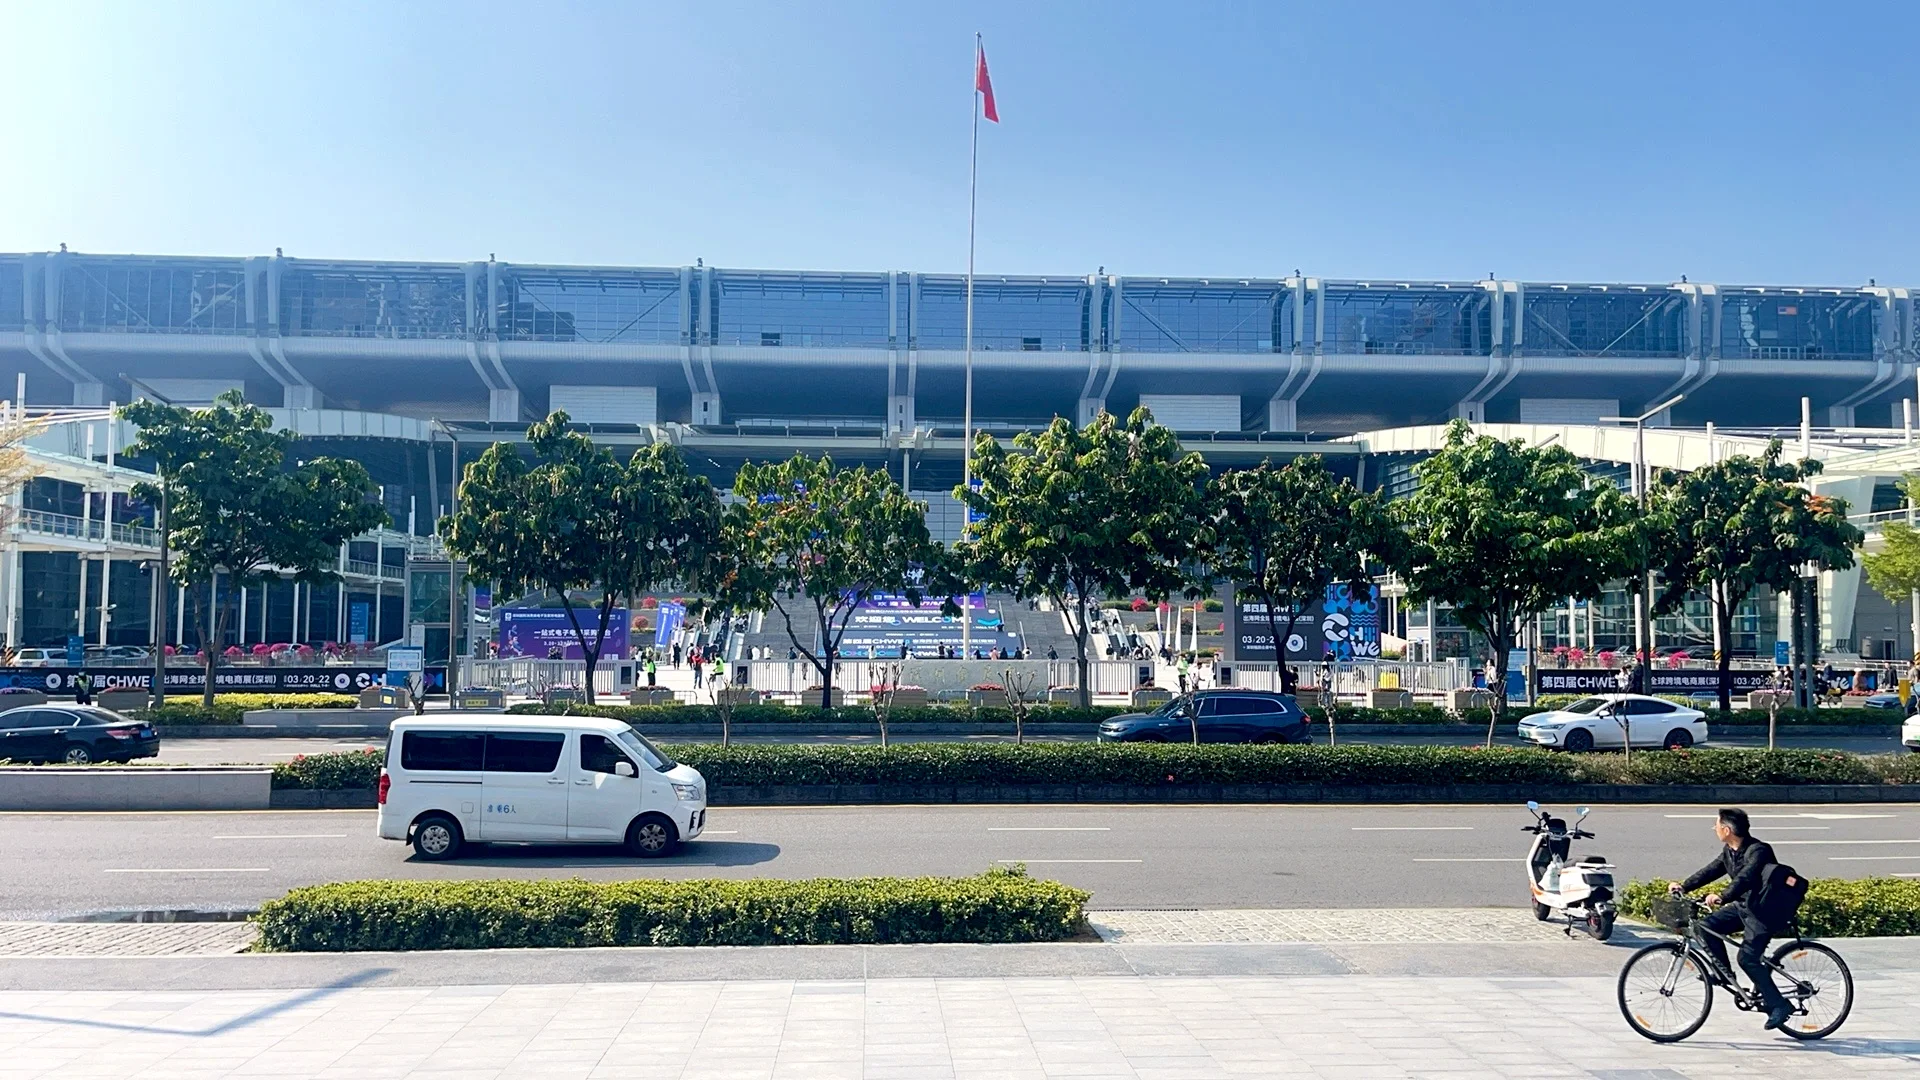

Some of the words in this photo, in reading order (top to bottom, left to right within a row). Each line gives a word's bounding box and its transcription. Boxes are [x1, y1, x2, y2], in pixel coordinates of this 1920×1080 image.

[1243, 604, 1295, 612] 第四届HW
[534, 629, 611, 637] 一站式电子电采购台
[67, 674, 150, 688] 第届CHWE
[164, 675, 277, 685] 出海网全球境电商展(深圳)
[1542, 676, 1616, 688] 第四届CHWE
